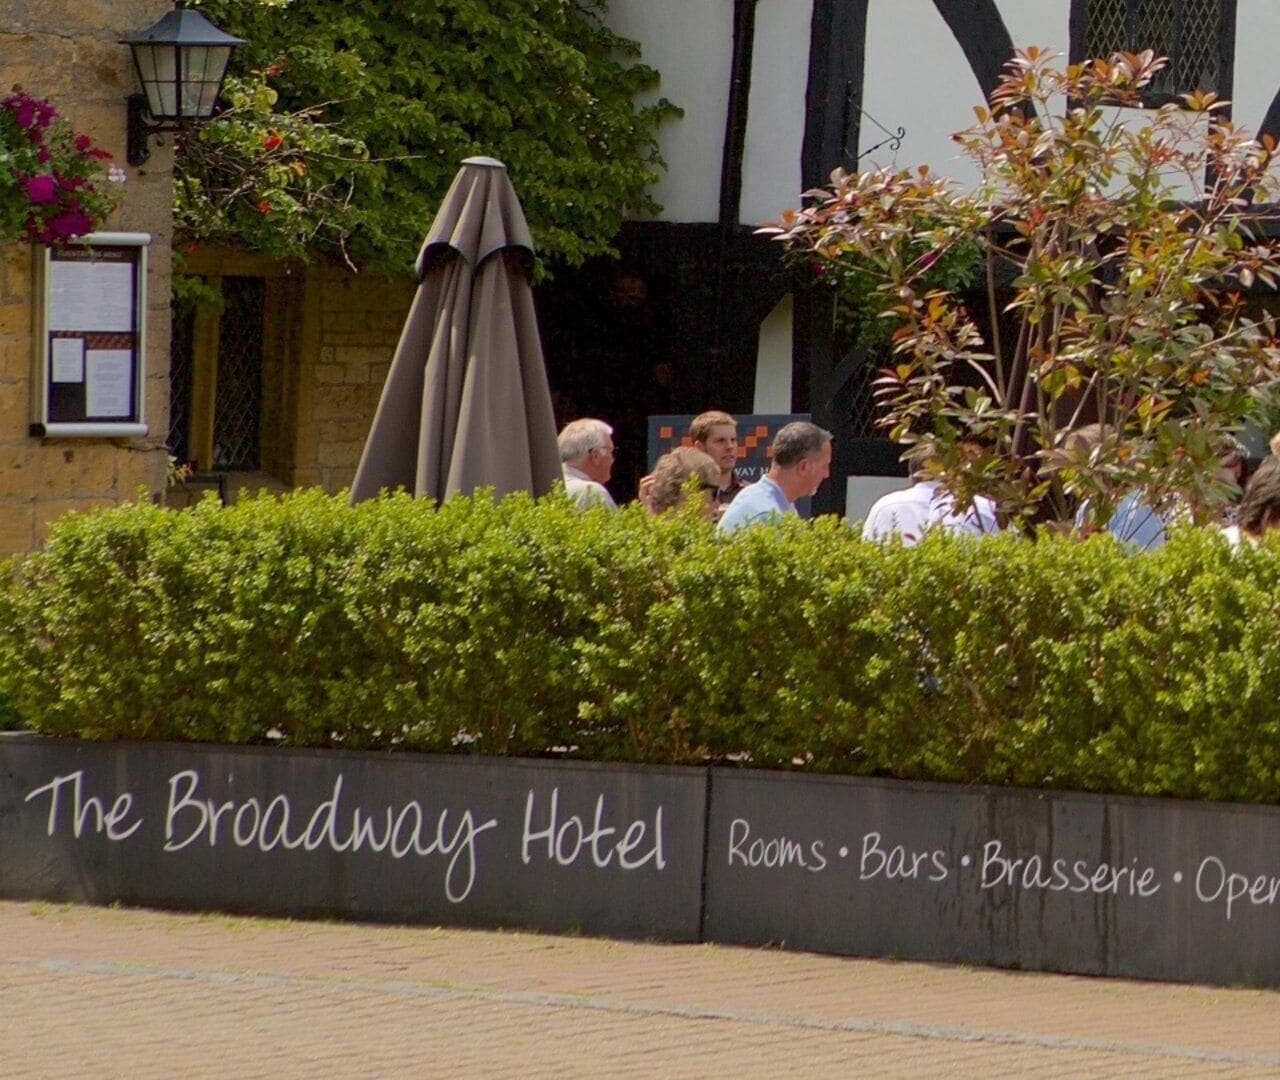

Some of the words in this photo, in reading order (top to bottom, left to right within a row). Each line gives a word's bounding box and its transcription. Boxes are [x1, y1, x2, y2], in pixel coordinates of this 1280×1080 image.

[24, 770, 143, 841] The
[164, 770, 497, 904] Broadway
[522, 787, 666, 871] Hotel
[728, 818, 827, 873] Rooms
[859, 832, 948, 881] Bars
[980, 840, 1161, 897] Brasserie
